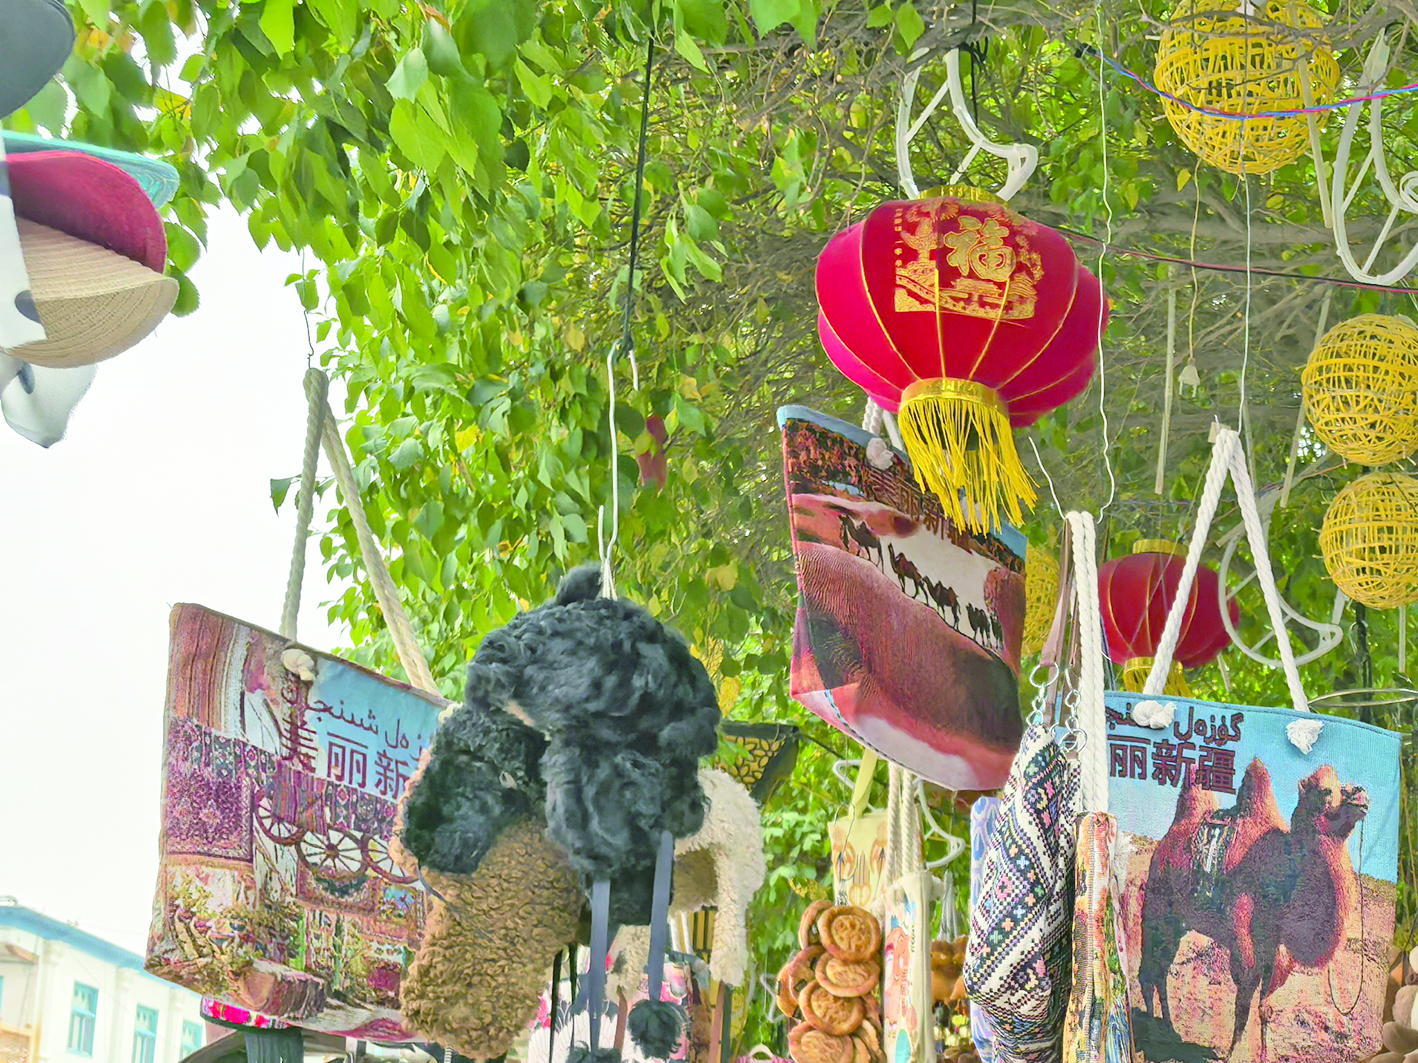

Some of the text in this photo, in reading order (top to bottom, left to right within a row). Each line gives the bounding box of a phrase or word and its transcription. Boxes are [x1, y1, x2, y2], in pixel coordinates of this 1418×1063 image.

[943, 215, 1017, 282] 福
[1107, 734, 1237, 795] 丽新疆
